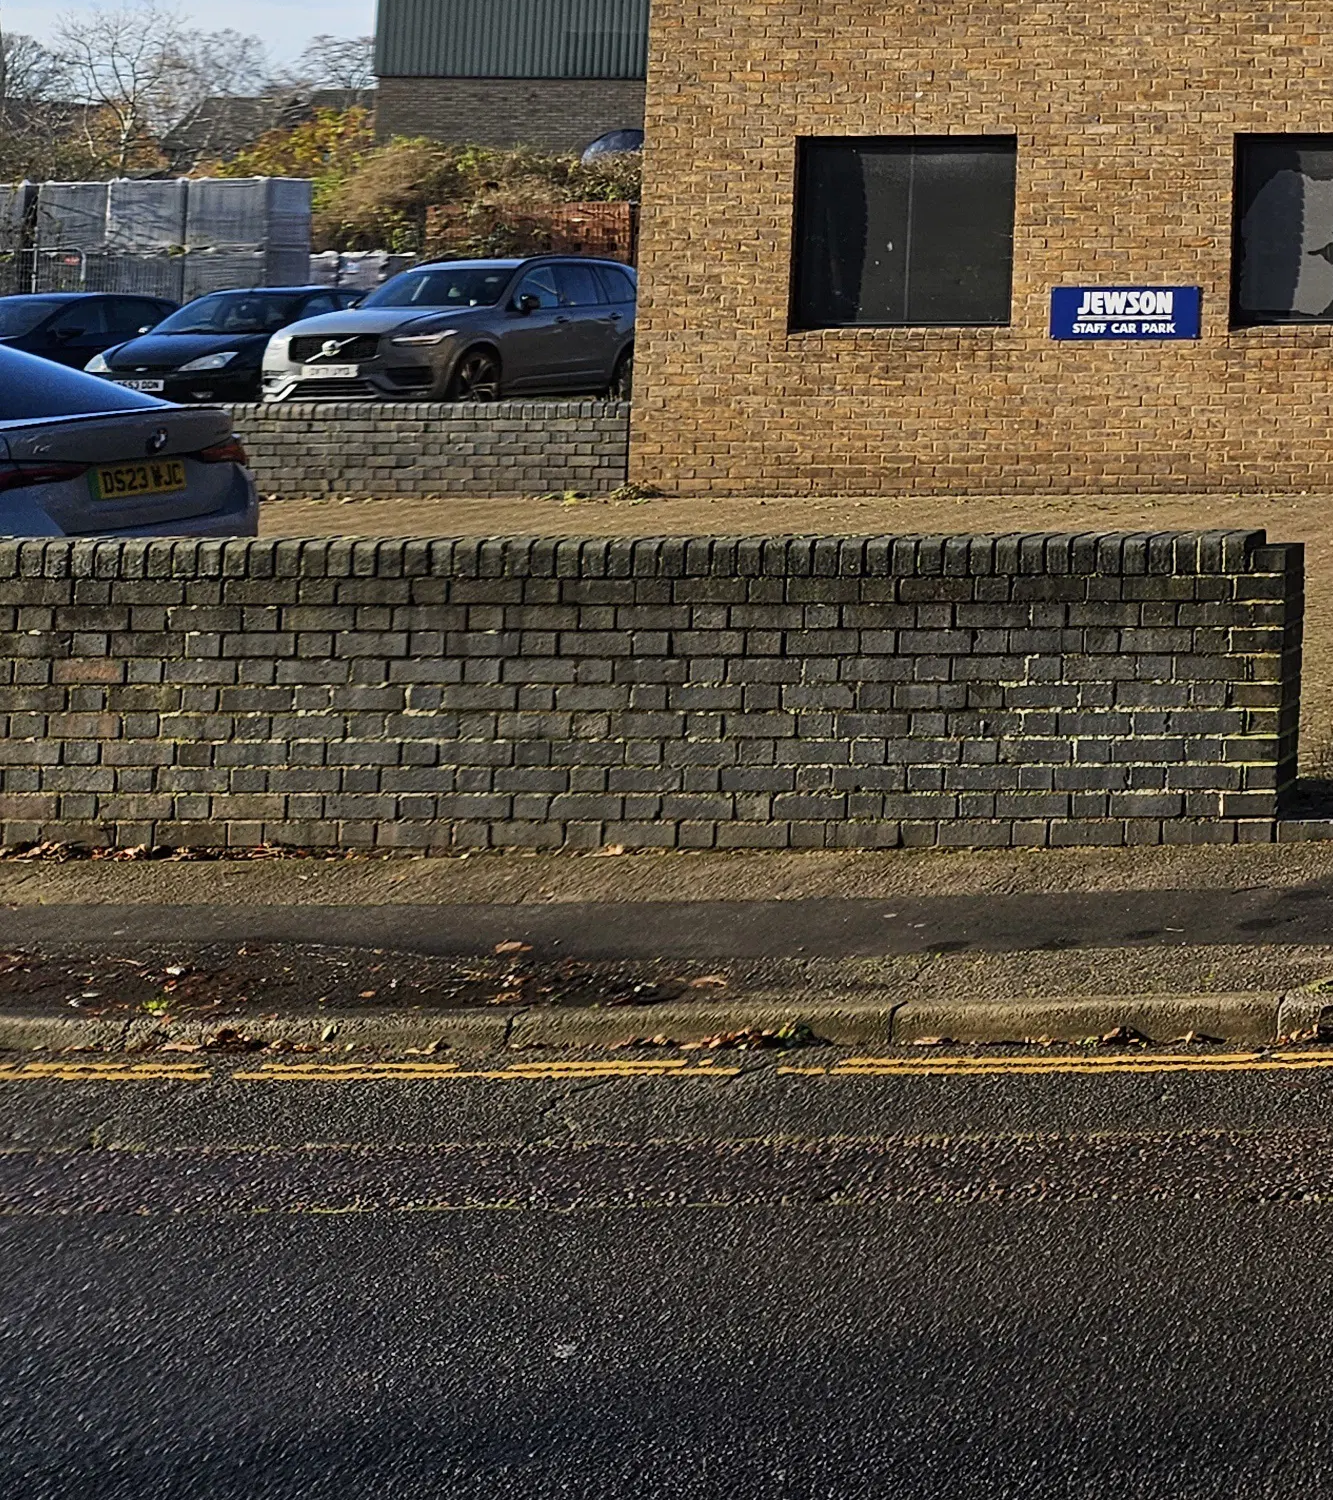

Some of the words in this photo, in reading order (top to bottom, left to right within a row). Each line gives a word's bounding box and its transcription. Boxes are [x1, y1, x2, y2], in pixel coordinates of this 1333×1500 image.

[1077, 291, 1173, 315] JEWSON
[1072, 323, 1107, 333] STAFF
[1111, 323, 1137, 333] CAR
[1141, 323, 1176, 333] PARK
